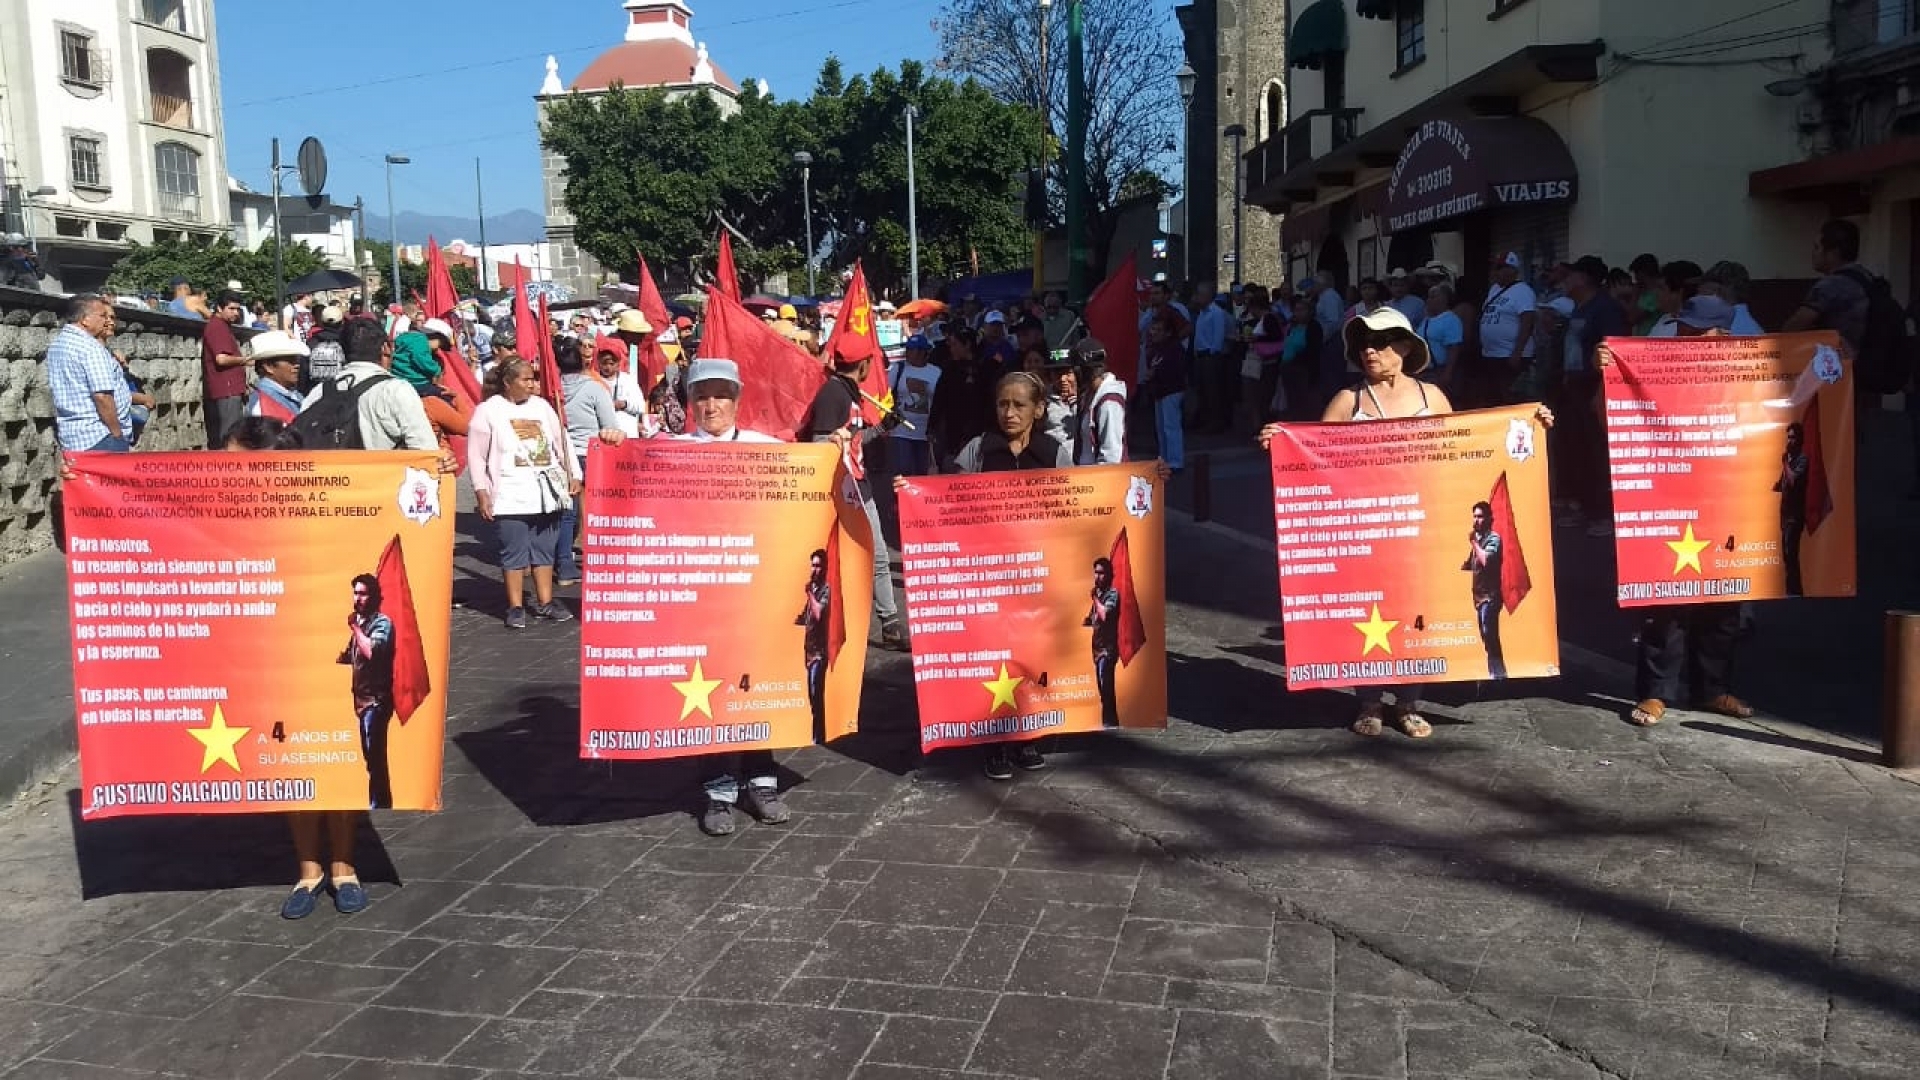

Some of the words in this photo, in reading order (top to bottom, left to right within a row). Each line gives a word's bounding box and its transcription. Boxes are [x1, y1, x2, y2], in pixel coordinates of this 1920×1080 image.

[1389, 131, 1421, 203] AGENCIA
[1422, 120, 1434, 141] DE
[1437, 120, 1470, 160] VIAJES
[1494, 180, 1570, 202] VIAJES
[1390, 211, 1416, 231] VIAJES
[1418, 205, 1434, 223] CON
[1417, 428, 1470, 440] COMUNITARIO
[134, 461, 202, 472] ASOCIACIÓN
[207, 461, 243, 472] CÍVICA
[249, 461, 315, 472] MORELENSE
[146, 477, 219, 488] DESARROLLO
[222, 477, 262, 487] SOCIAL
[265, 477, 271, 487] Y
[274, 476, 350, 487] COMUNITARIO
[217, 492, 258, 505] Salgado
[308, 492, 329, 502] A.C.
[766, 491, 788, 501] PARA
[790, 491, 800, 501] EL
[119, 506, 203, 518] ORGANIZACIÓN
[204, 507, 212, 517] Y
[215, 507, 252, 518] LUCHA
[255, 507, 276, 518] POR
[278, 507, 286, 517] Y
[288, 507, 317, 517] PARA
[319, 507, 332, 517] EL
[335, 506, 382, 517] PUEBLO"
[587, 515, 609, 527] Para
[71, 537, 98, 552] Para
[100, 538, 152, 553] nosotros,
[1725, 535, 1734, 552] 4
[72, 559, 85, 574] tu
[87, 558, 138, 574] recuerdo
[141, 558, 165, 574] será
[168, 558, 216, 575] siempre
[219, 561, 232, 573] un
[235, 558, 276, 576] girasol
[588, 553, 605, 565] que
[607, 554, 624, 565] nos
[74, 582, 97, 597] que
[99, 582, 120, 594] nos
[122, 580, 178, 597] impulsará
[180, 582, 188, 594] a
[189, 580, 237, 594] levantar
[240, 579, 257, 594] los
[259, 579, 284, 595] ojos
[1655, 580, 1700, 598] SALGADO
[1703, 578, 1751, 595] DELGADO
[75, 602, 109, 617] hacia
[111, 601, 121, 616] el
[124, 601, 151, 616] cielo
[153, 604, 161, 618] y
[163, 603, 183, 616] nos
[185, 601, 231, 617] ayudará
[234, 603, 240, 616] a
[243, 601, 276, 616] andar
[77, 623, 96, 639] los
[98, 623, 146, 638] caminos
[148, 622, 162, 637] de
[165, 622, 175, 637] la
[177, 622, 210, 637] lucha
[1414, 615, 1425, 631] 4
[78, 647, 85, 662] y
[87, 645, 99, 660] la
[101, 645, 162, 660] esperanza.
[585, 645, 602, 658] Tus
[637, 646, 654, 659] que
[657, 645, 707, 658] caminaron
[600, 664, 625, 677] todas
[1290, 662, 1338, 684] GUSTAVO
[1342, 660, 1392, 679] SALGADO
[1395, 657, 1447, 676] DELGADO
[727, 683, 736, 693] A
[739, 674, 750, 692] 4
[787, 681, 801, 691] DE
[1038, 672, 1047, 687] 4
[80, 688, 102, 703] Tus
[105, 688, 141, 704] pasos,
[143, 688, 165, 703] que
[167, 686, 228, 701] caminaron
[726, 702, 742, 711] SU
[746, 699, 804, 710] ASESINATO
[82, 710, 97, 725] en
[99, 708, 133, 724] todas
[154, 706, 206, 722] marchas.
[970, 716, 1019, 737] SALGADO
[1022, 709, 1065, 732] DELGADO
[258, 733, 268, 744] A
[272, 721, 286, 743] 4
[290, 729, 329, 743] AÑOS
[333, 731, 352, 742] DE
[590, 729, 649, 750] GUSTAVO
[653, 726, 711, 748] SALGADO
[715, 723, 771, 744] DELGADO
[258, 753, 276, 765] SU
[281, 751, 358, 765] ASESINATO
[92, 782, 168, 806] GUSTAVO
[171, 780, 242, 803] SALGADO
[246, 778, 316, 801] DELGADO
